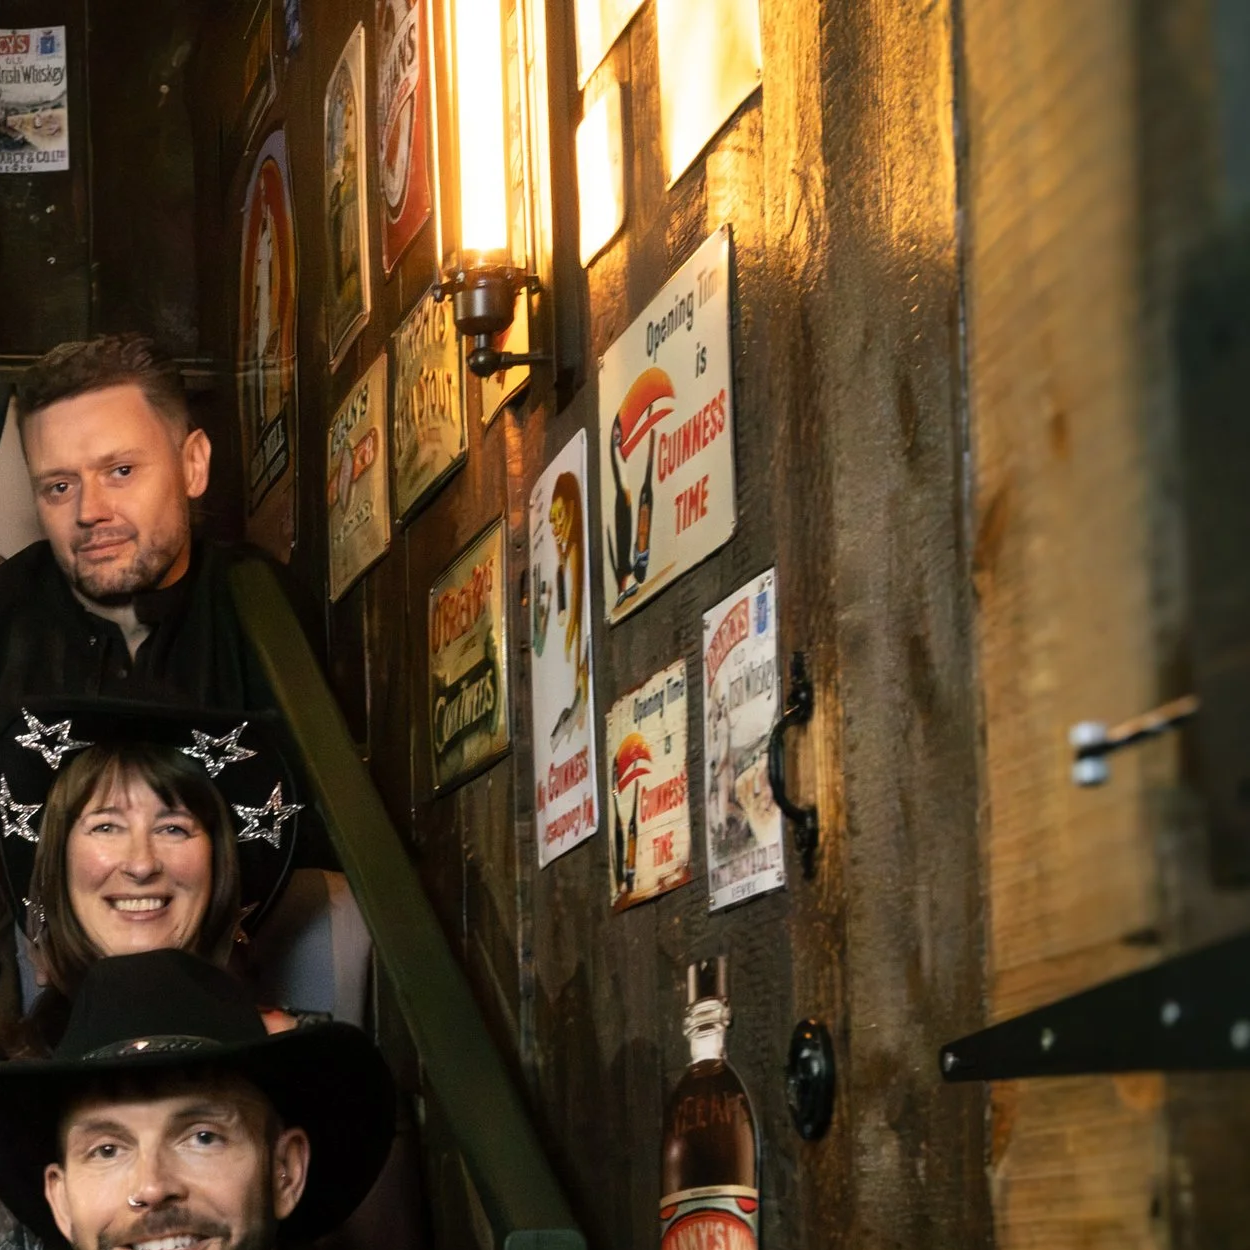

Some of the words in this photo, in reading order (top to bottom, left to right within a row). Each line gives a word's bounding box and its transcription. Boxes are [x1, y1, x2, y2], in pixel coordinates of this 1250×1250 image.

[21, 63, 66, 87] Whiskey
[646, 290, 694, 364] Opening
[695, 341, 707, 379] is
[657, 387, 726, 484] GUINNESS
[674, 473, 710, 536] TIME
[548, 744, 589, 802] GUINNESS
[639, 766, 688, 824] GUINNESS
[652, 830, 675, 869] TIME
